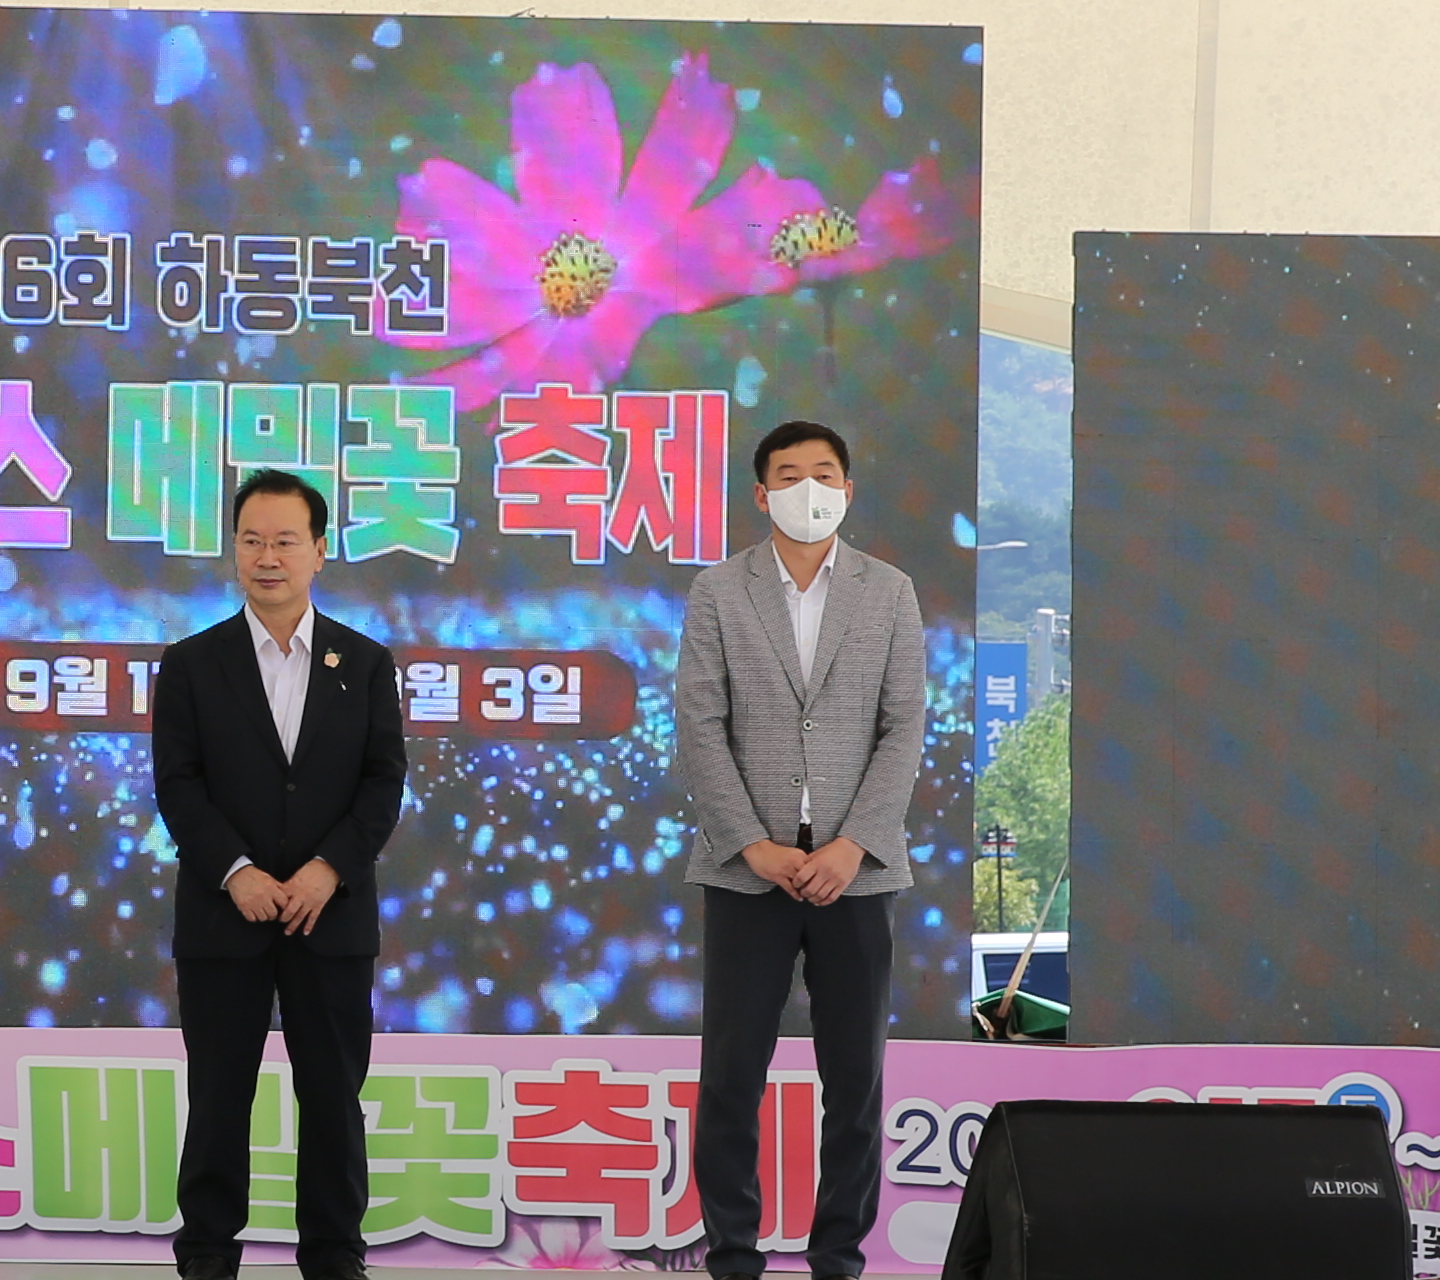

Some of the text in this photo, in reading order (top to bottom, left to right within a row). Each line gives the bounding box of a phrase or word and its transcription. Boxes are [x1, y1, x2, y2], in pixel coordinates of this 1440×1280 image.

[156, 232, 450, 336] 하동북천
[493, 383, 729, 566] 축제
[6, 656, 109, 716] 9월
[480, 663, 582, 725] 3일
[1311, 1180, 1380, 1196] ALPION
